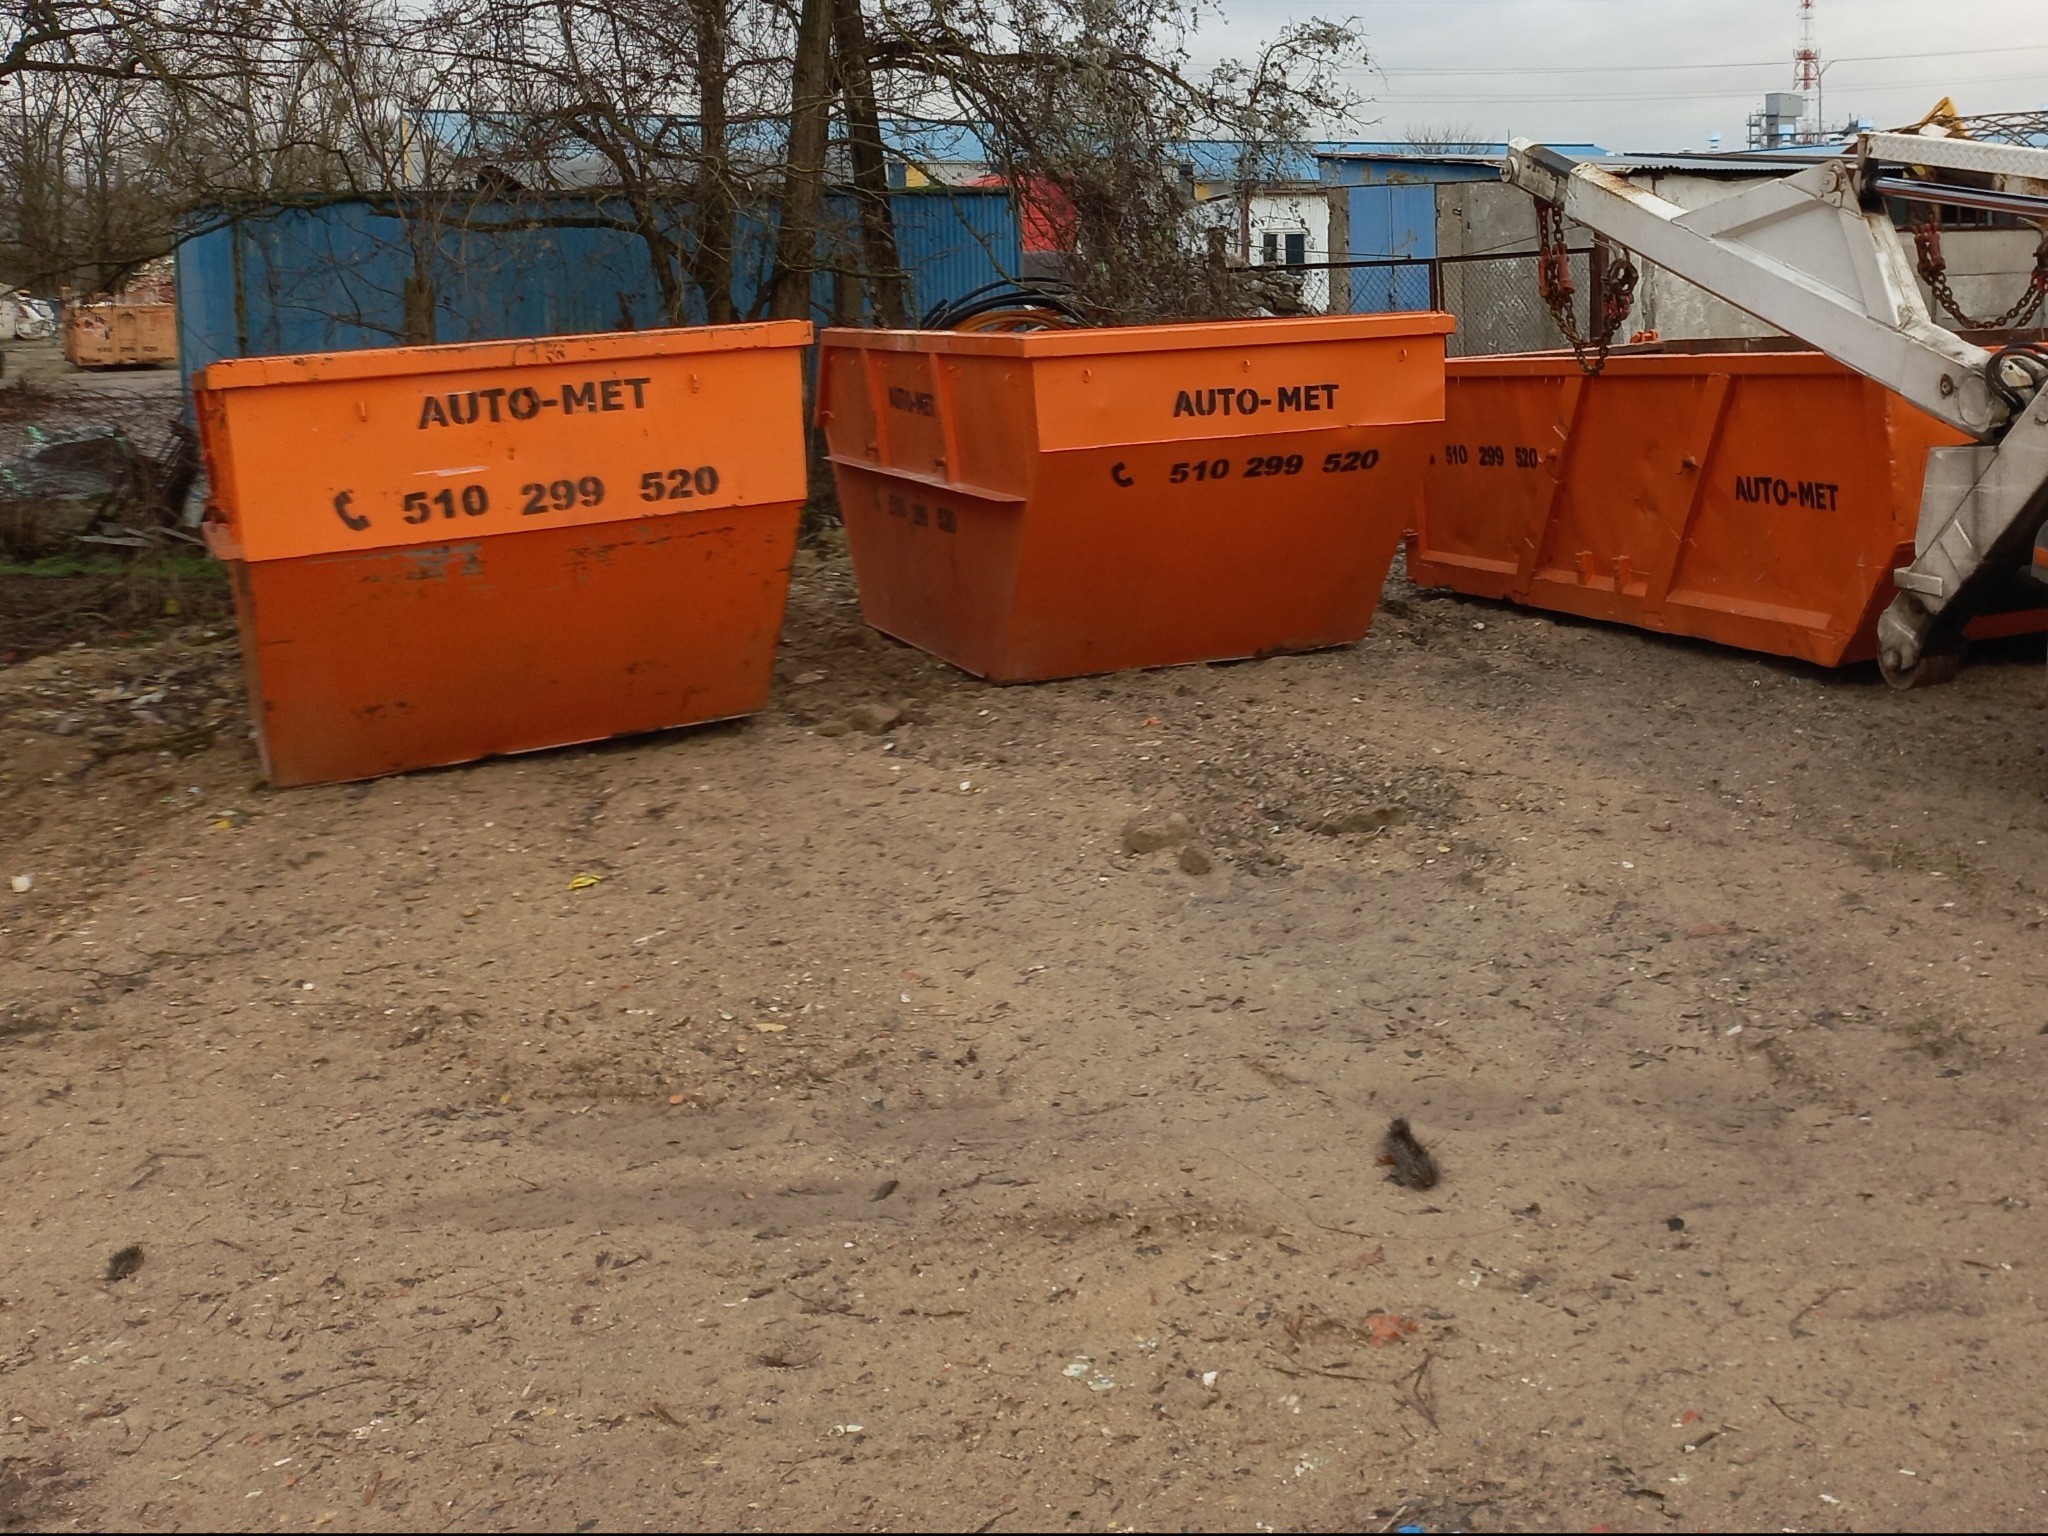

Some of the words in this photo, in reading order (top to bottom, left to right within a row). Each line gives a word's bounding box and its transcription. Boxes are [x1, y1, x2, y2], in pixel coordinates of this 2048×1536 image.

[418, 378, 651, 430] AUTO-MET
[1173, 384, 1340, 417] AUTO-MET
[1169, 459, 1230, 483] 510
[1243, 454, 1304, 479] 299
[1321, 449, 1379, 473] 520
[1445, 445, 1468, 465] 510
[1478, 446, 1504, 467] 299
[1515, 447, 1538, 469] 520
[403, 485, 489, 525] 510
[520, 476, 606, 516] 299
[639, 466, 720, 502] 520
[1736, 475, 1839, 512] AUTO-MET
